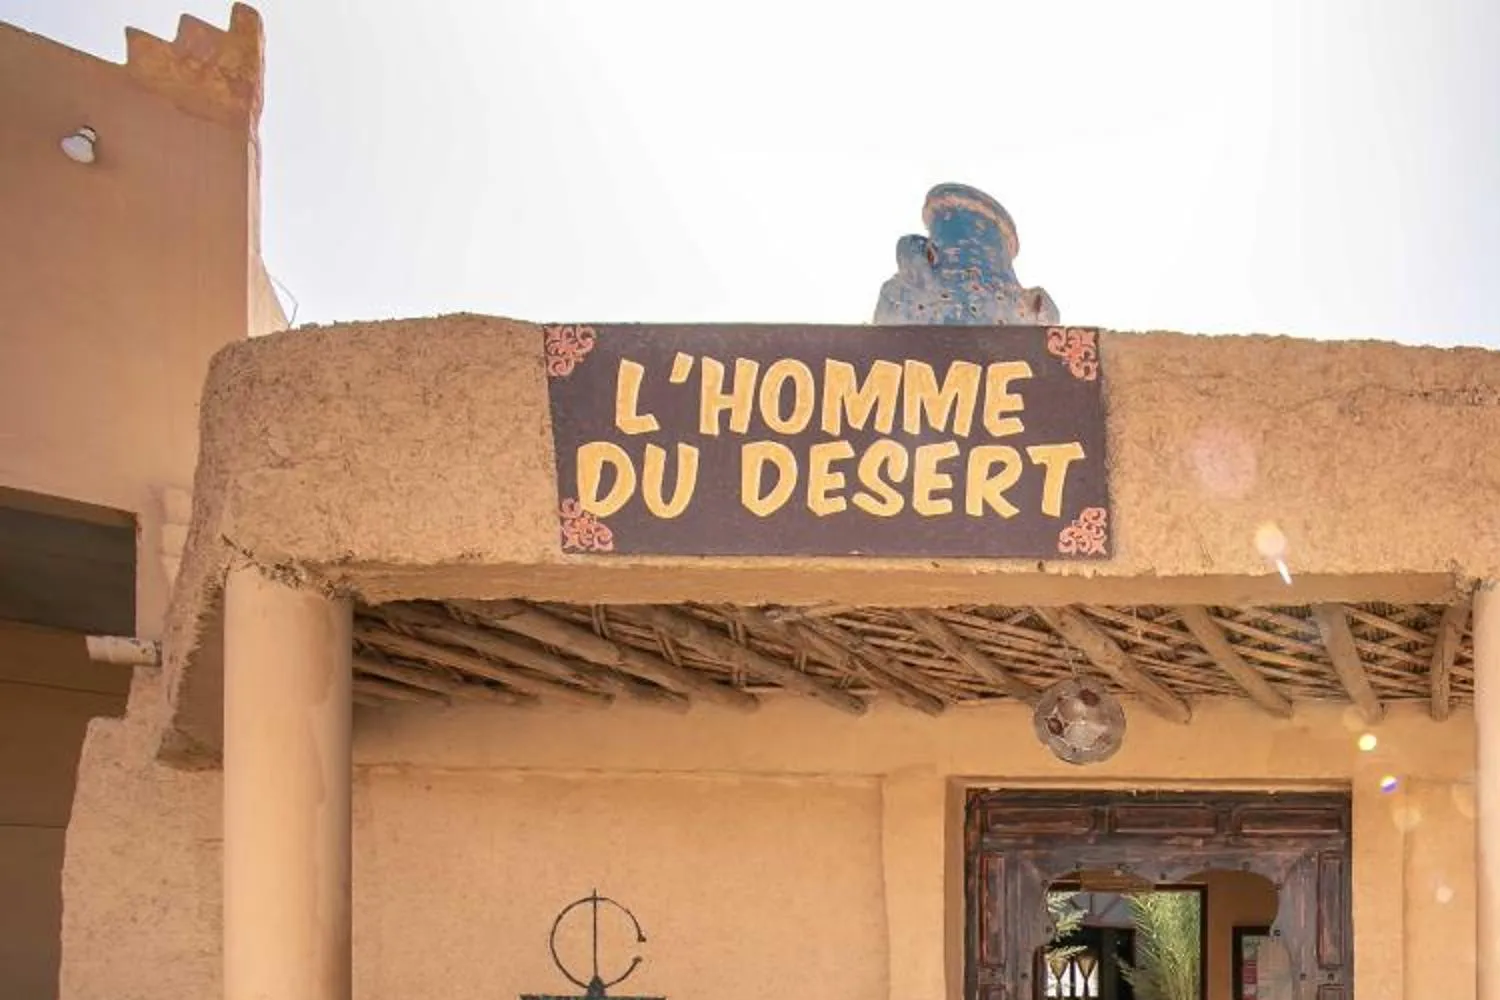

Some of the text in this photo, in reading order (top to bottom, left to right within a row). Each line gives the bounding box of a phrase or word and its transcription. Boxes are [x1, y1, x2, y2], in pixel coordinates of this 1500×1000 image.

[615, 351, 1034, 437] L'HOMME
[576, 439, 1086, 519] DU DESERT
